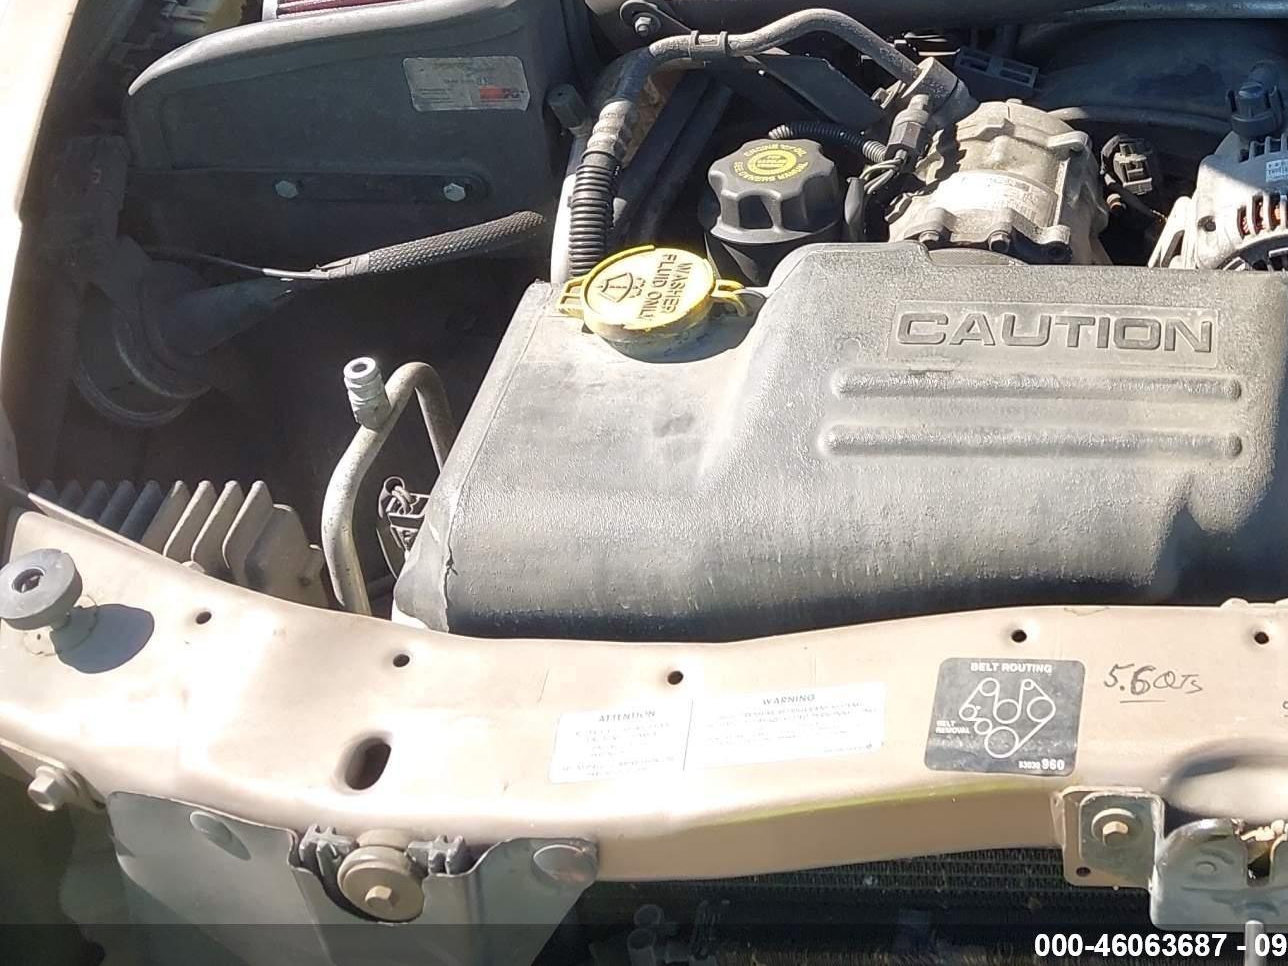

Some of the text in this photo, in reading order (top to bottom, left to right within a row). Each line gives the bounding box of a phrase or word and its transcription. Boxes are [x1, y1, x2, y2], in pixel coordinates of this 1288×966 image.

[638, 253, 677, 320] FLUID ONLY
[662, 262, 693, 314] WASHER
[897, 312, 1213, 353] CAUTION
[970, 662, 1052, 673] BELT ROUTING
[762, 693, 816, 706] WARNING
[598, 710, 656, 722] ATTENTION
[1041, 758, 1065, 770] 960
